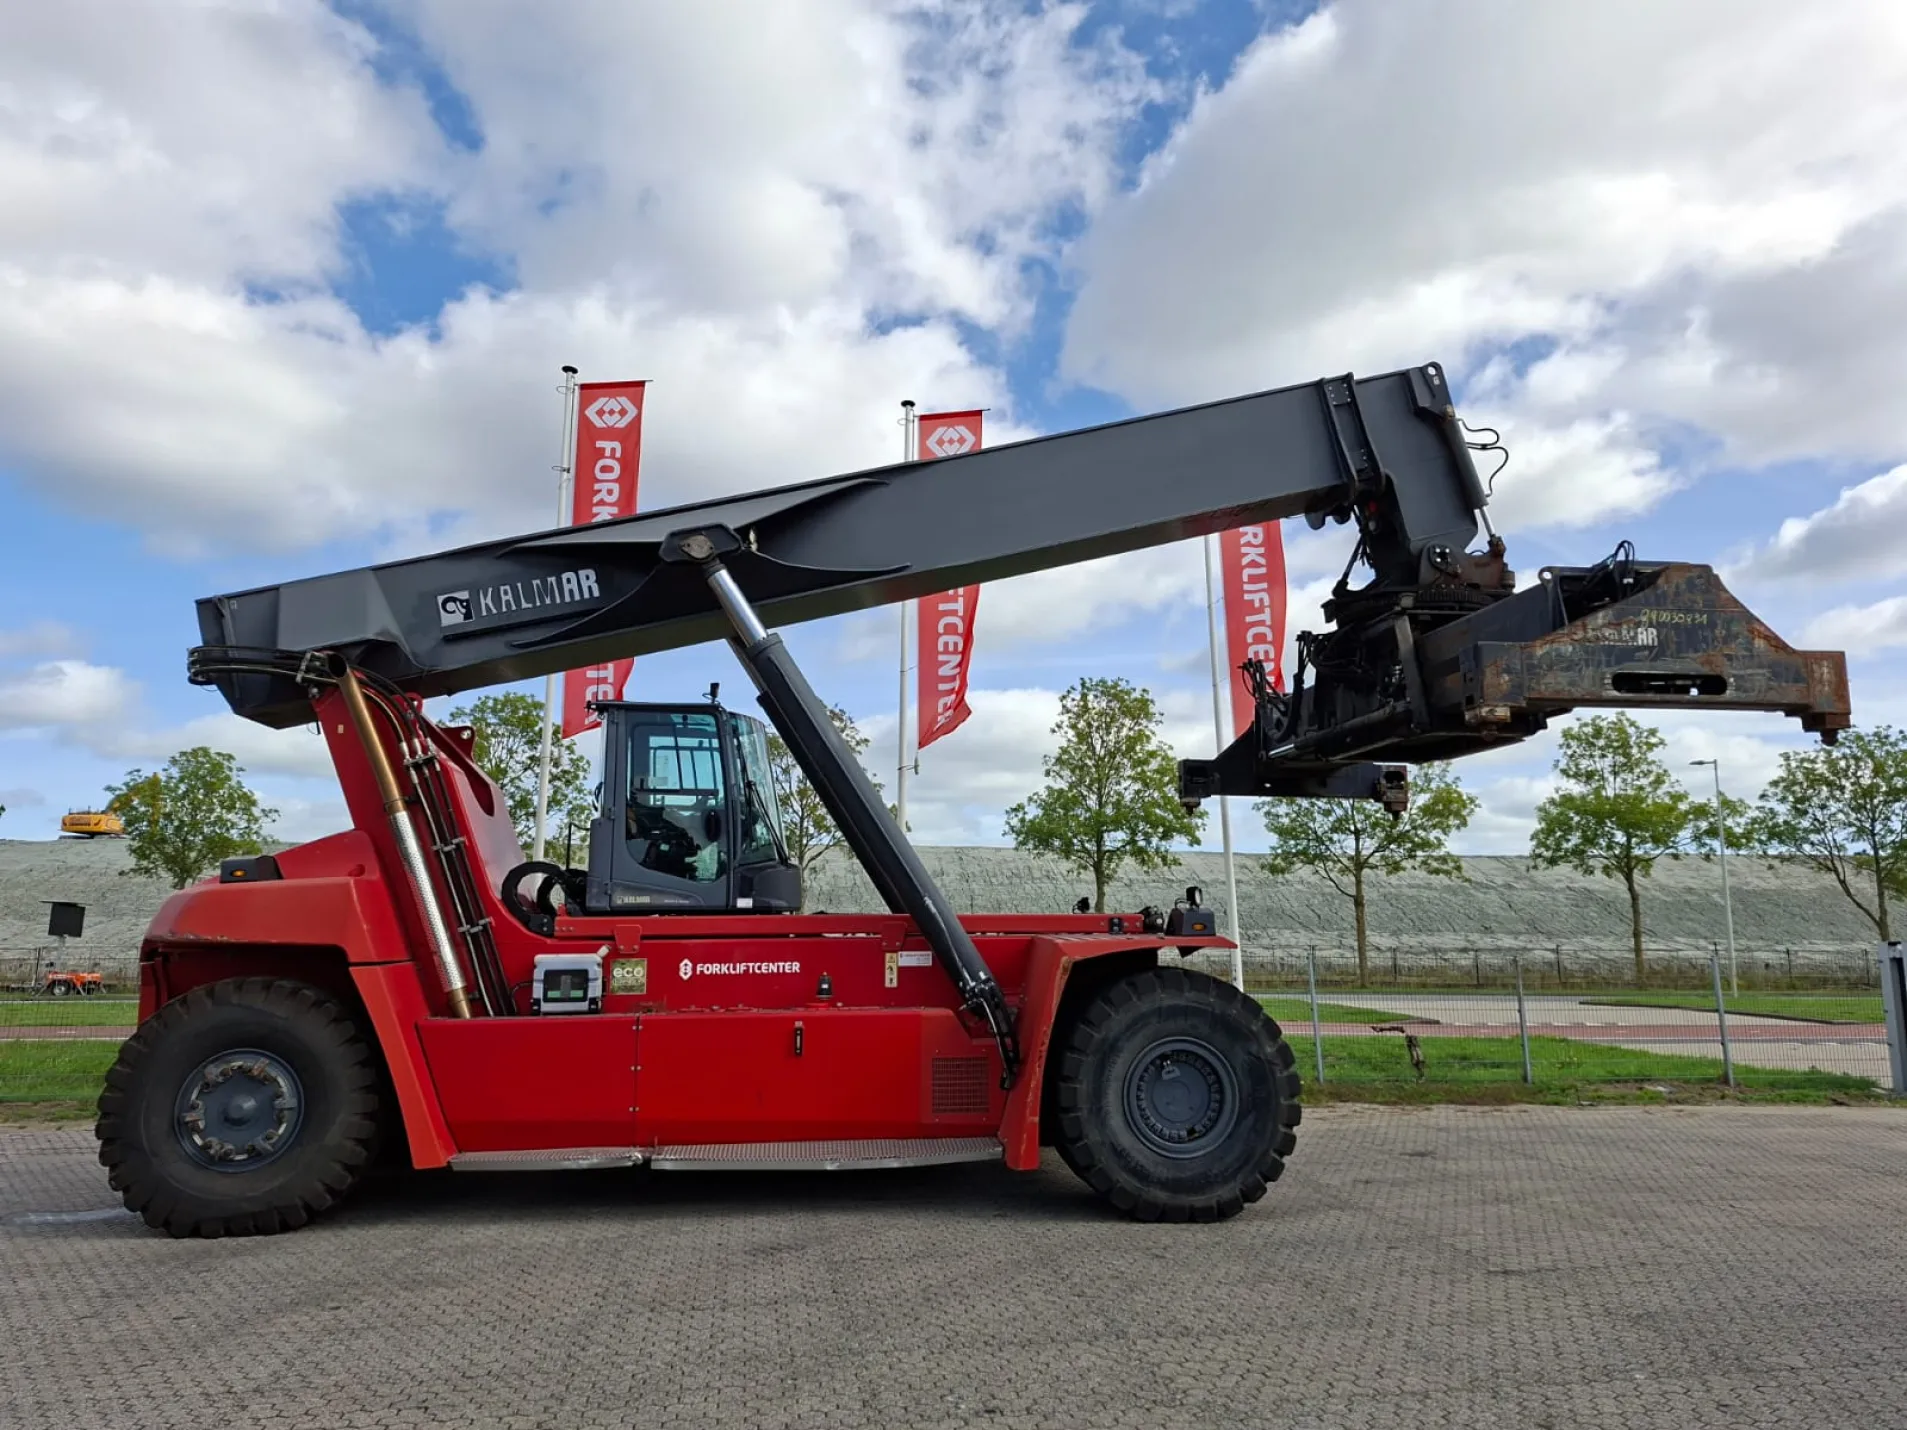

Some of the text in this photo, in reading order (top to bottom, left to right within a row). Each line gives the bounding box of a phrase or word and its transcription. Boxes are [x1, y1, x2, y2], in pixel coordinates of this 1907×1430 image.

[479, 569, 599, 616] KALMAR
[613, 967, 644, 978] eco
[696, 961, 800, 975] FORKLIFTCENTER
